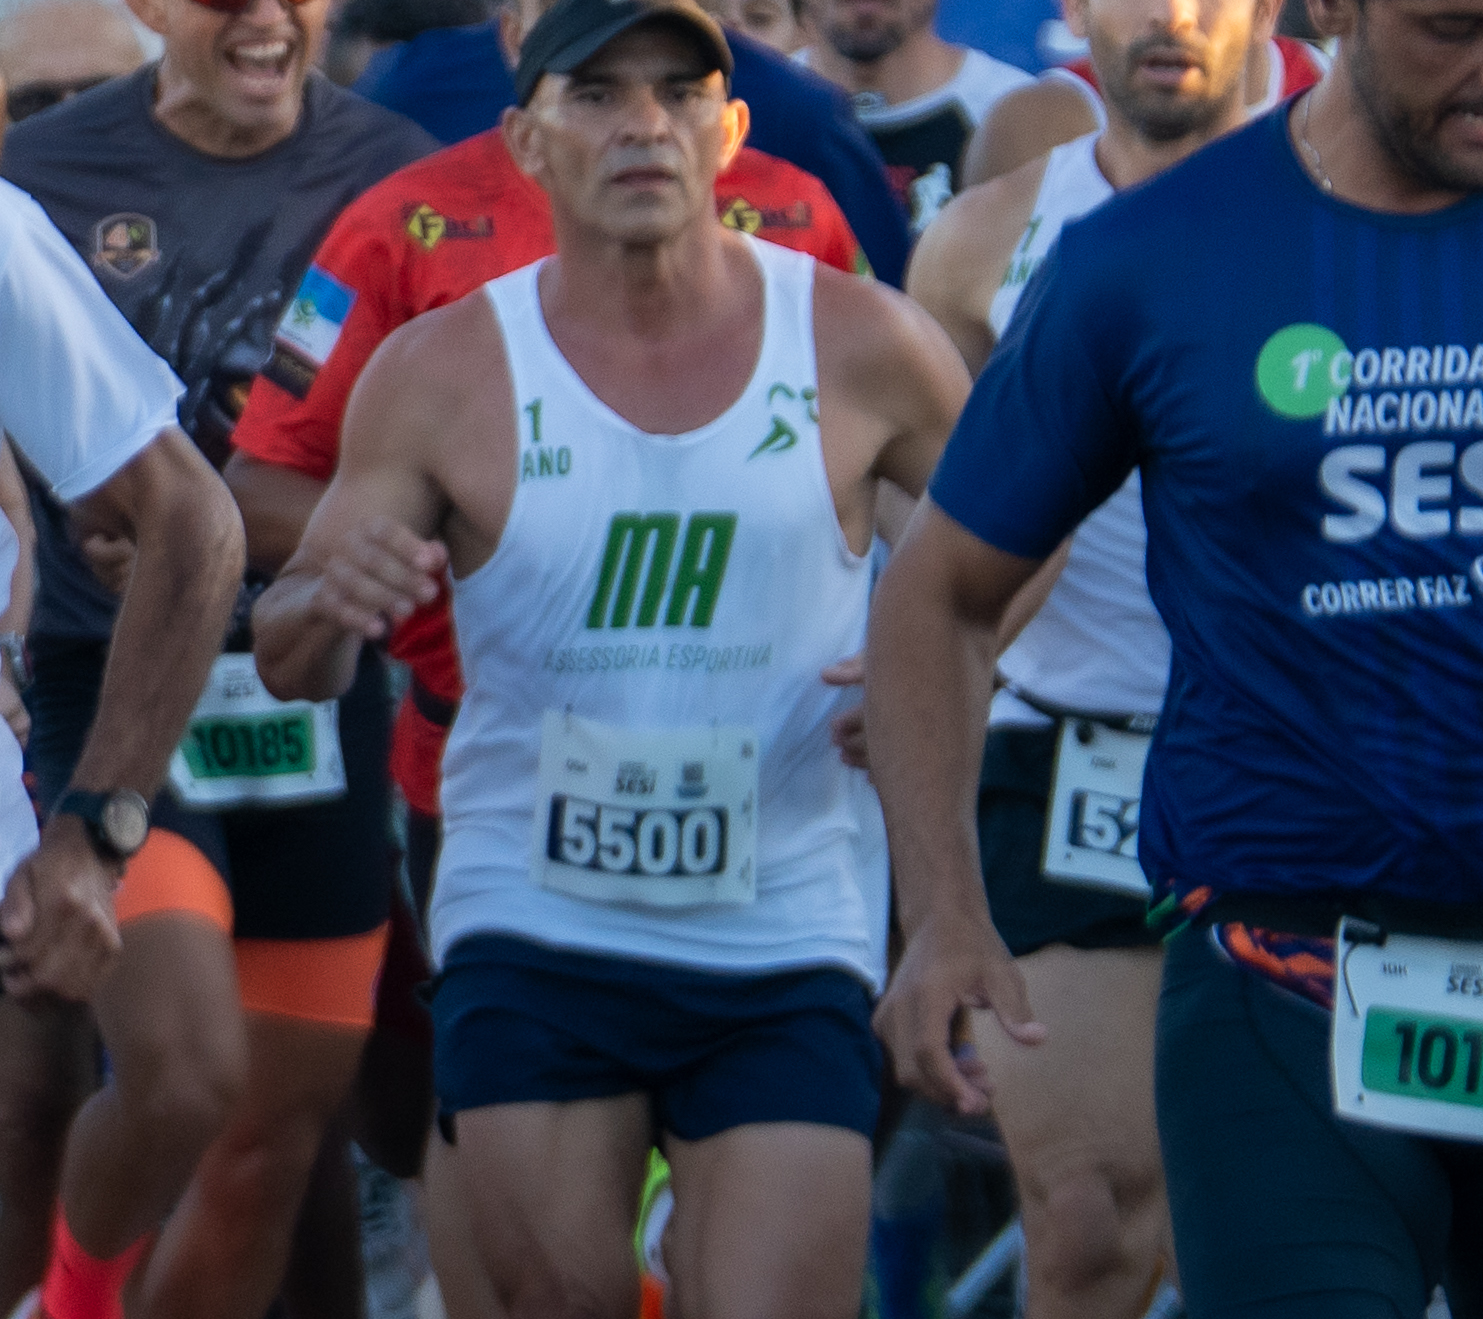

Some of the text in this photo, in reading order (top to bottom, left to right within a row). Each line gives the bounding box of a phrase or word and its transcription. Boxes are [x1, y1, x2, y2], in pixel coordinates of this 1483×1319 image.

[523, 398, 543, 442] 1
[521, 446, 572, 482] ANO
[586, 509, 739, 630] MA
[1301, 578, 1417, 618] CORRER
[1419, 574, 1472, 609] FAZ
[561, 795, 721, 875] 5500
